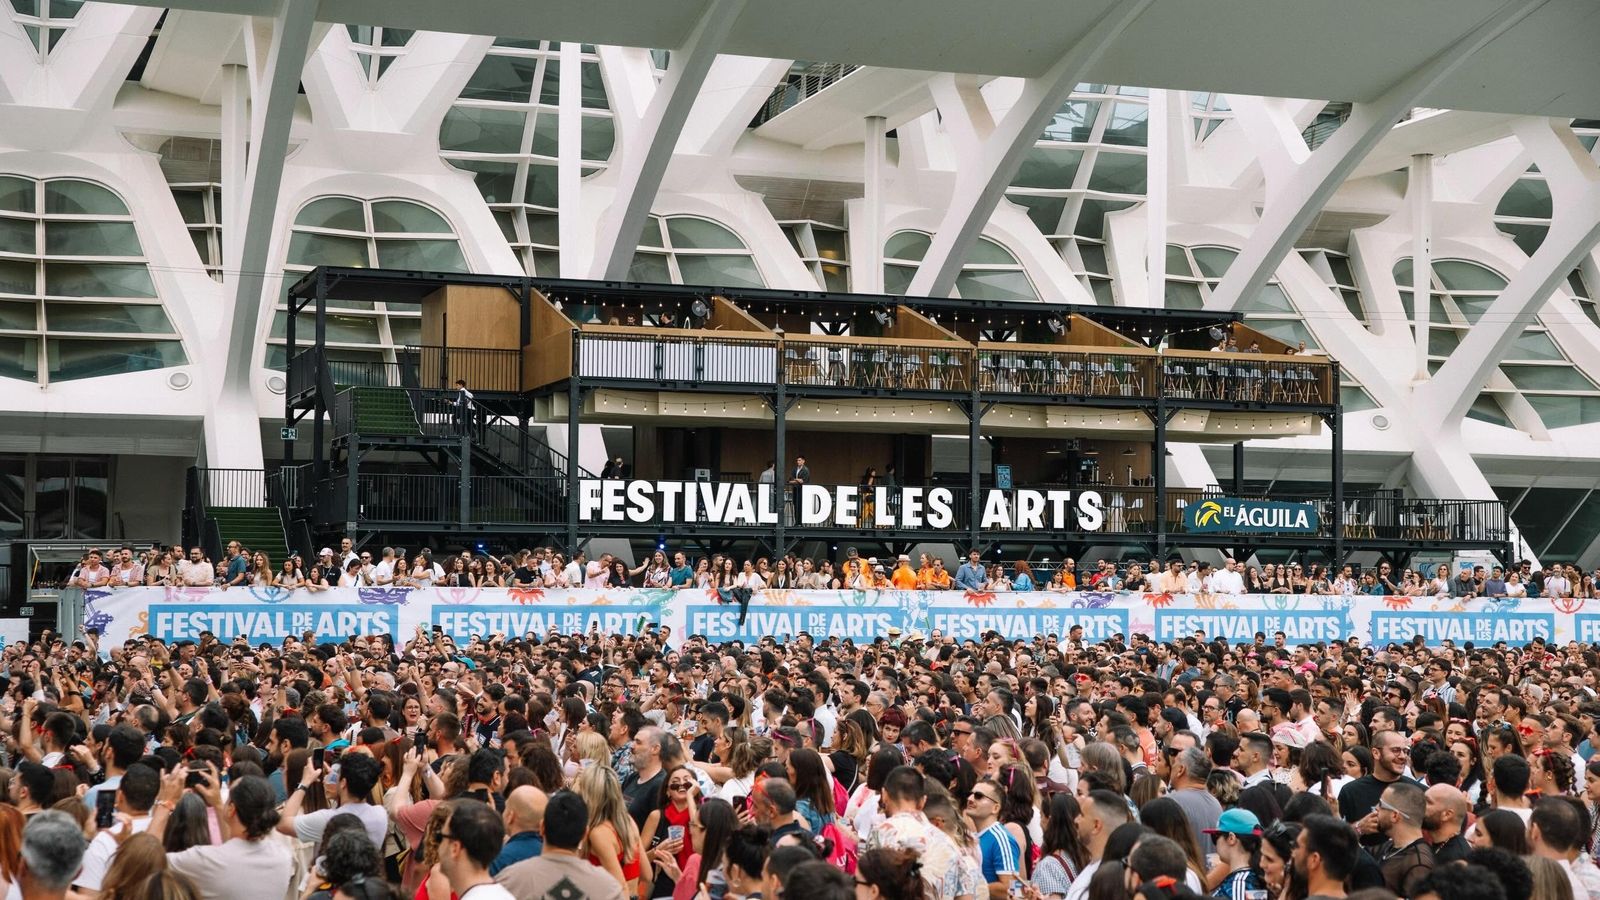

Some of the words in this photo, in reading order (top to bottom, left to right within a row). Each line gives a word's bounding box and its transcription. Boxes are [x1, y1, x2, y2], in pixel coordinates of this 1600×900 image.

[579, 479, 778, 523] FESTIVAL
[801, 485, 858, 525] DE
[875, 487, 953, 529] LES
[980, 489, 1103, 531] ARTS
[1223, 506, 1235, 518] EL
[1235, 504, 1309, 529] ÁGUILA
[157, 611, 289, 638] FESTIVAL
[292, 611, 313, 627] DE
[316, 611, 390, 637] ARTS
[563, 612, 582, 627] DE
[693, 611, 803, 637] FESTIVAL
[808, 613, 826, 626] DE
[829, 613, 893, 637] ARTS
[934, 614, 1037, 638] FESTIVAL
[1042, 615, 1059, 629] DE
[1061, 615, 1122, 638] ARTS
[1161, 615, 1260, 638] FESTIVAL
[1265, 616, 1281, 629] DE
[1283, 616, 1340, 639] ARTS
[1377, 617, 1475, 640] FESTIVAL
[1476, 618, 1491, 632] DE
[1494, 618, 1549, 641] ARTS
[808, 627, 826, 637] LES
[1265, 628, 1279, 638] LE
[1476, 631, 1491, 641] LES
